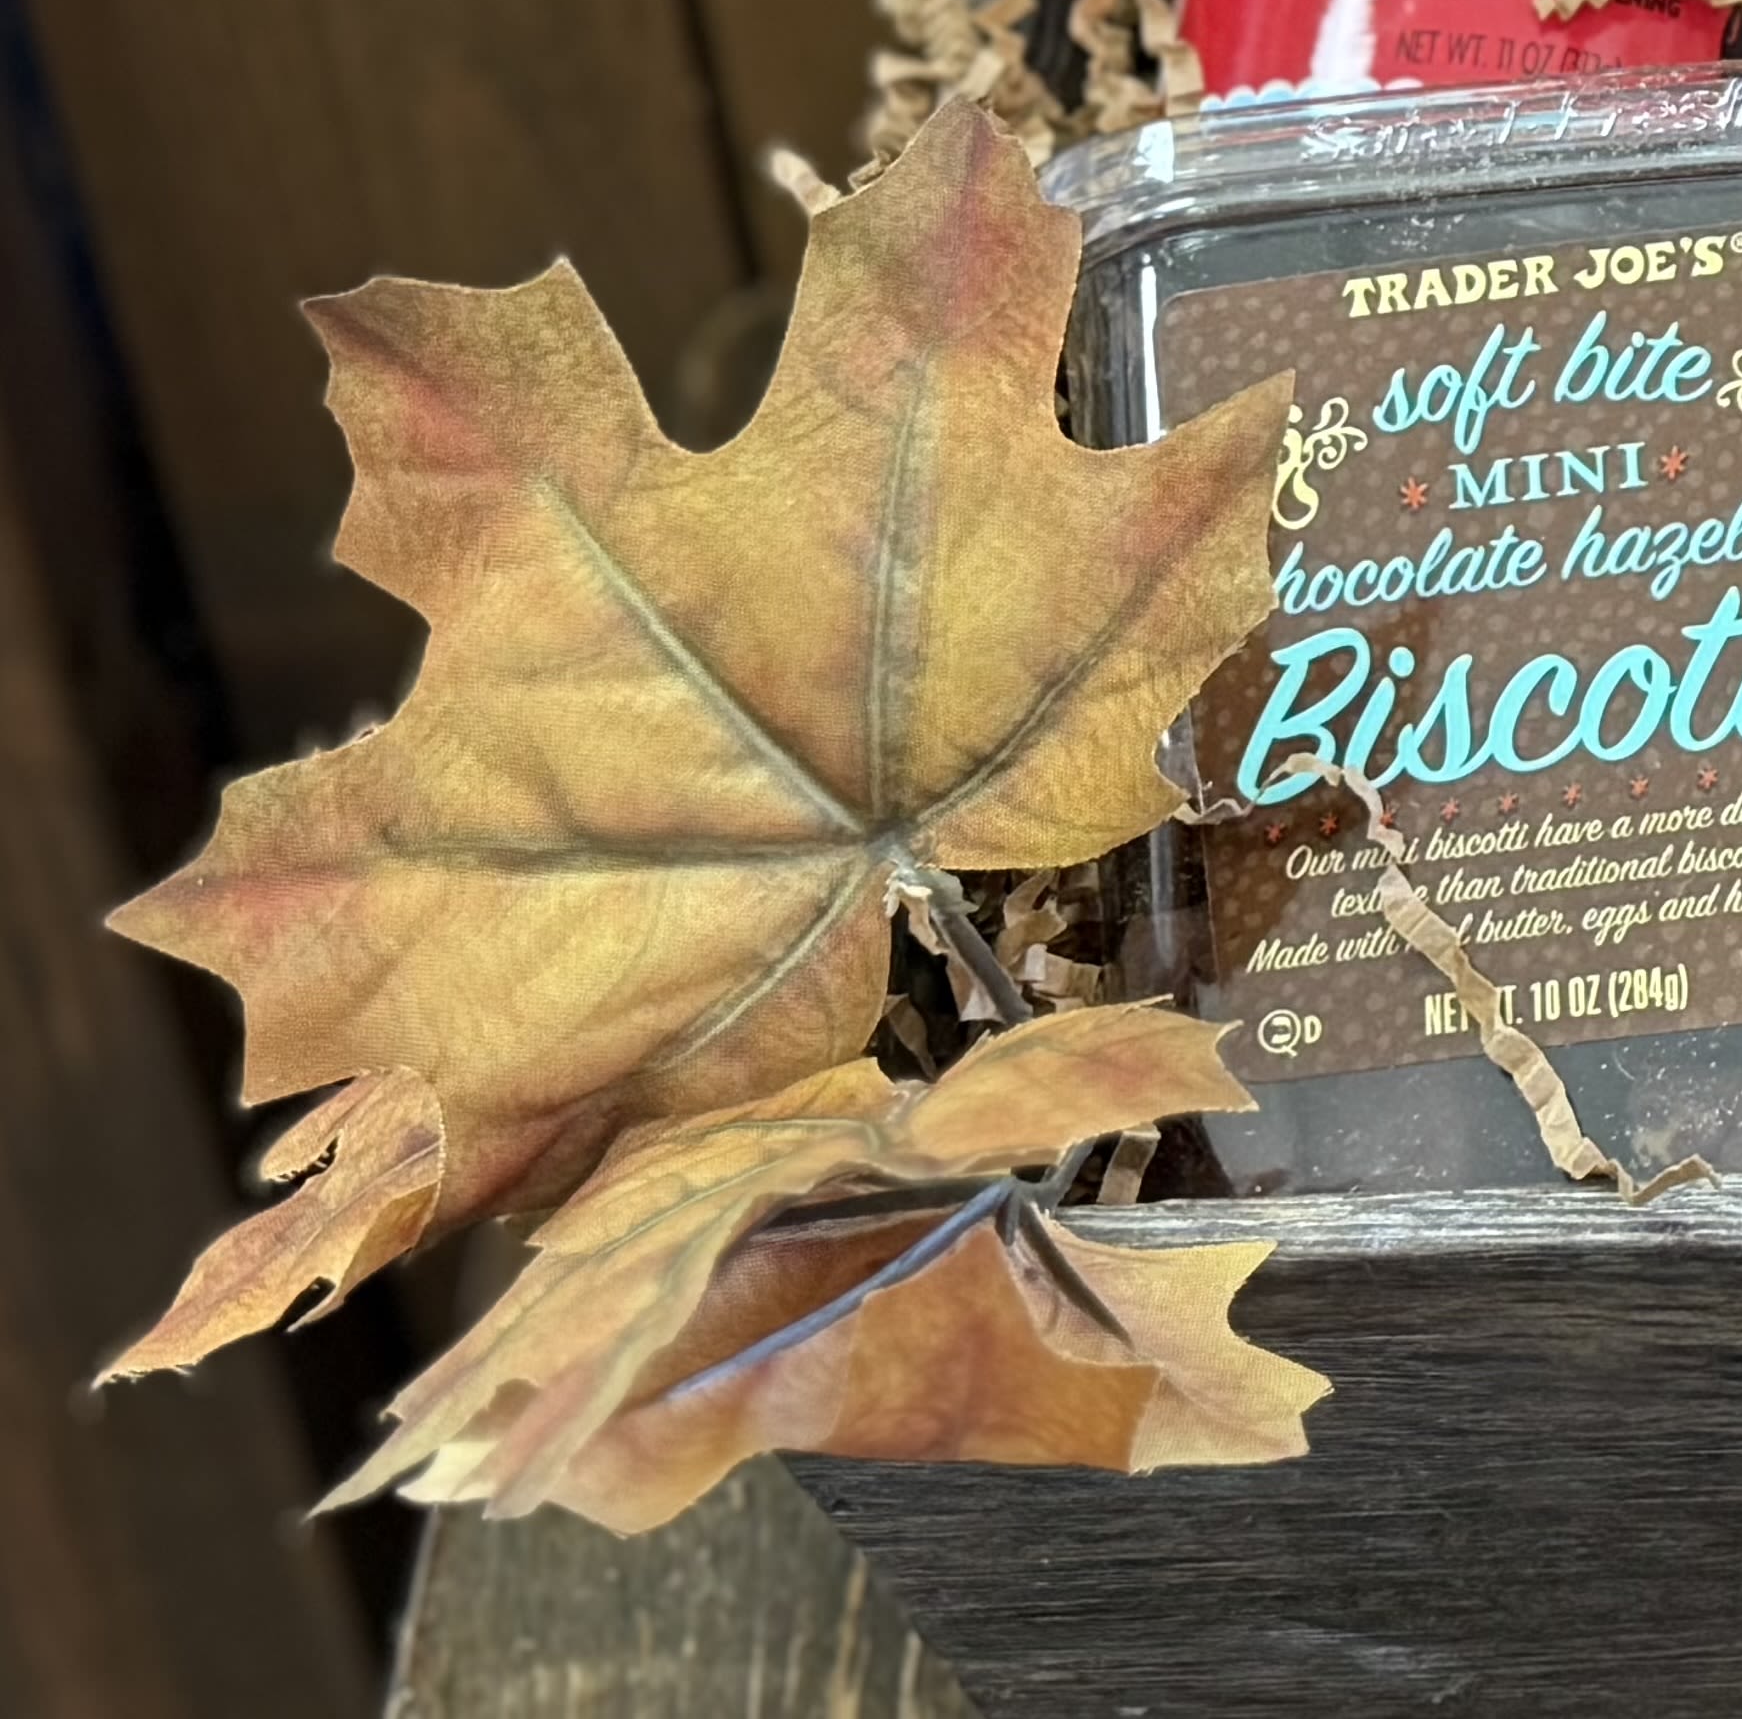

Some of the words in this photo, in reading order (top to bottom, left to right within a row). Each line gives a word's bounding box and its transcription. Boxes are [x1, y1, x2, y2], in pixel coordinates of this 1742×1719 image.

[1396, 31, 1440, 64] NET
[1449, 34, 1488, 69] WT.
[1342, 255, 1558, 319] TRADER
[1370, 321, 1543, 457] soft
[1553, 309, 1714, 407] bite
[1448, 442, 1649, 511] MINI
[1272, 524, 1548, 617] hocolate
[1285, 844, 1347, 881] Our
[1425, 820, 1530, 863] biscotti
[1533, 812, 1605, 848] have
[1609, 815, 1635, 840] a
[1638, 804, 1715, 836] more
[1330, 883, 1430, 919] texte
[1435, 867, 1506, 906] than
[1510, 843, 1675, 895] traditional
[1246, 934, 1330, 974] Made
[1335, 926, 1401, 964] with
[1581, 900, 1653, 947] eggs
[1658, 882, 1719, 922] and
[1530, 979, 1562, 1022] 10
[1567, 974, 1603, 1018] OZ
[1607, 962, 1690, 1018] (284g)
